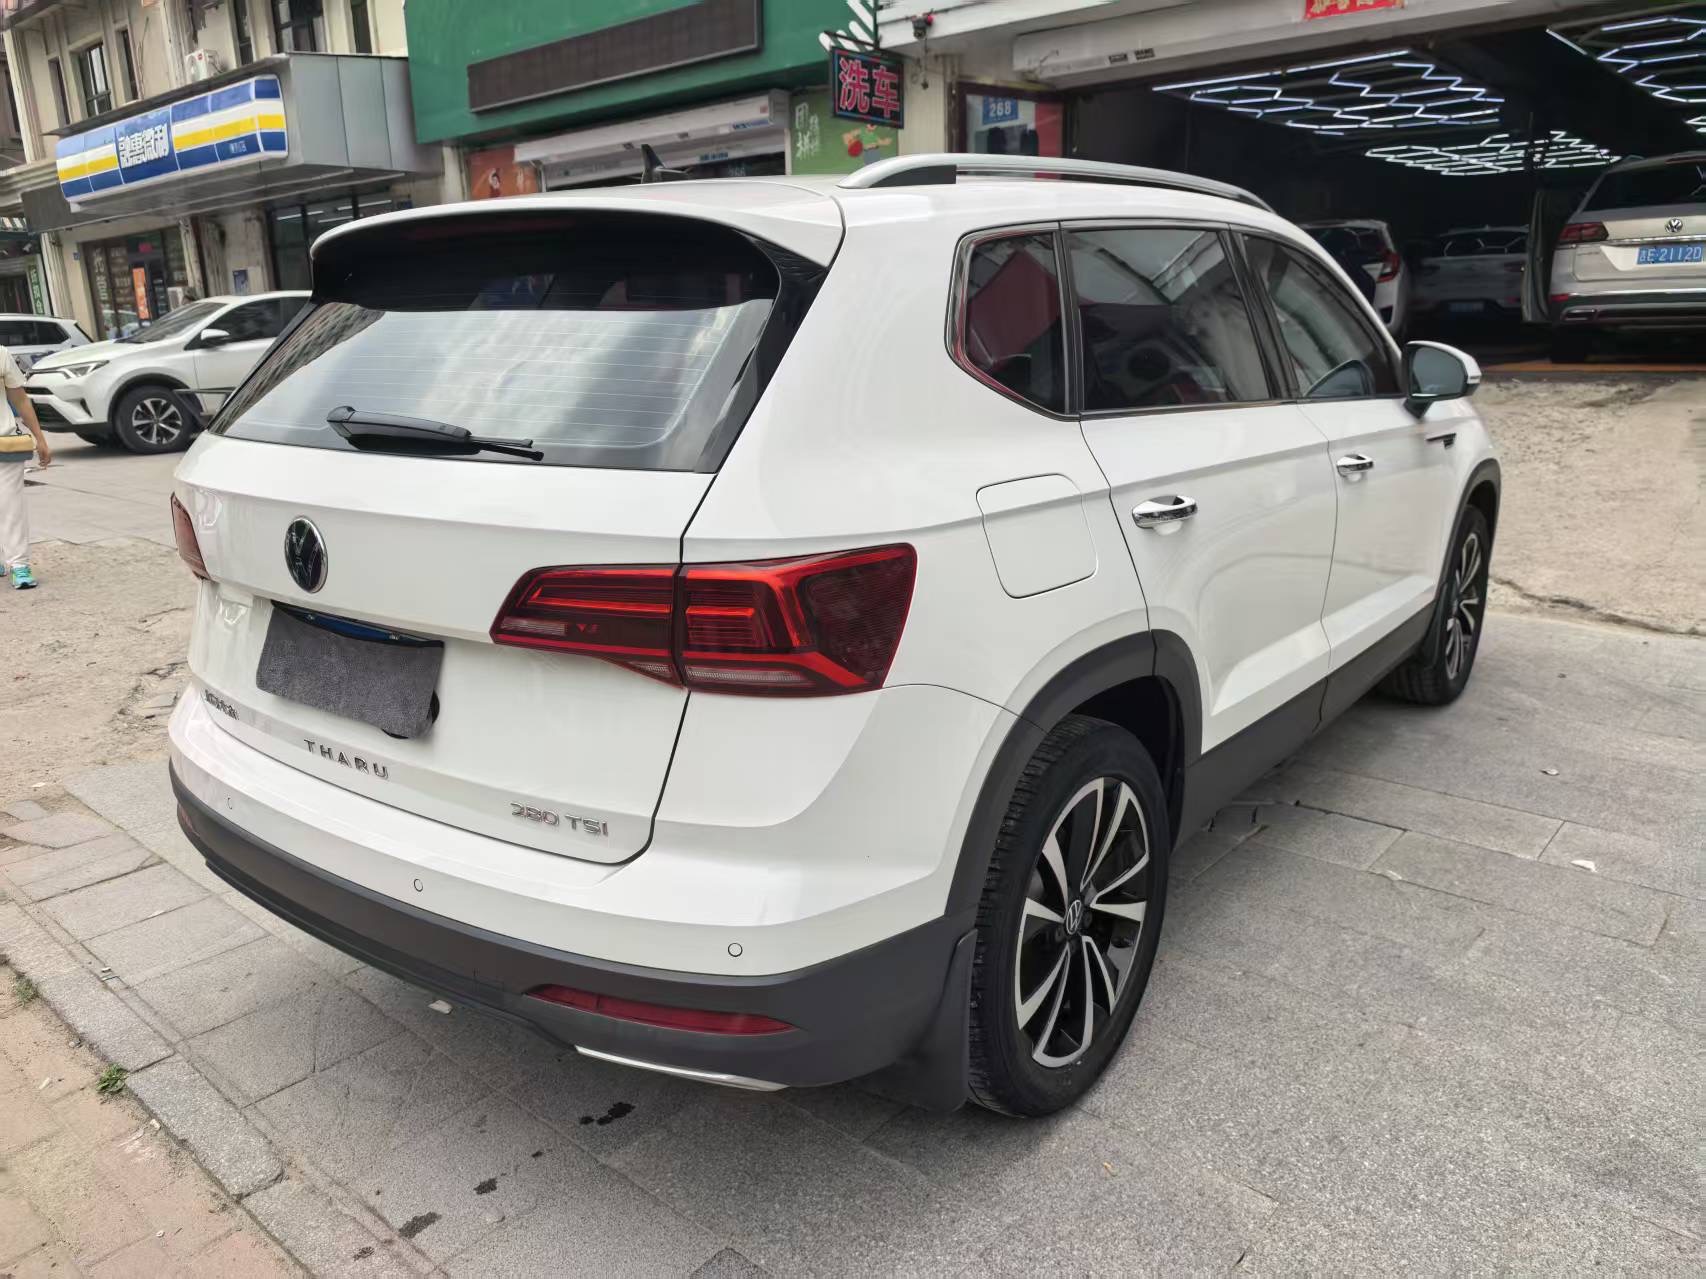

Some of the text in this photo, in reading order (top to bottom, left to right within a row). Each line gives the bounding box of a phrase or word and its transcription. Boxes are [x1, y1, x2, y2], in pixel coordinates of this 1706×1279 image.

[839, 57, 900, 118] 洗车
[990, 101, 1012, 117] 268
[303, 739, 389, 780] THARU
[511, 802, 609, 837] 280 TSI
